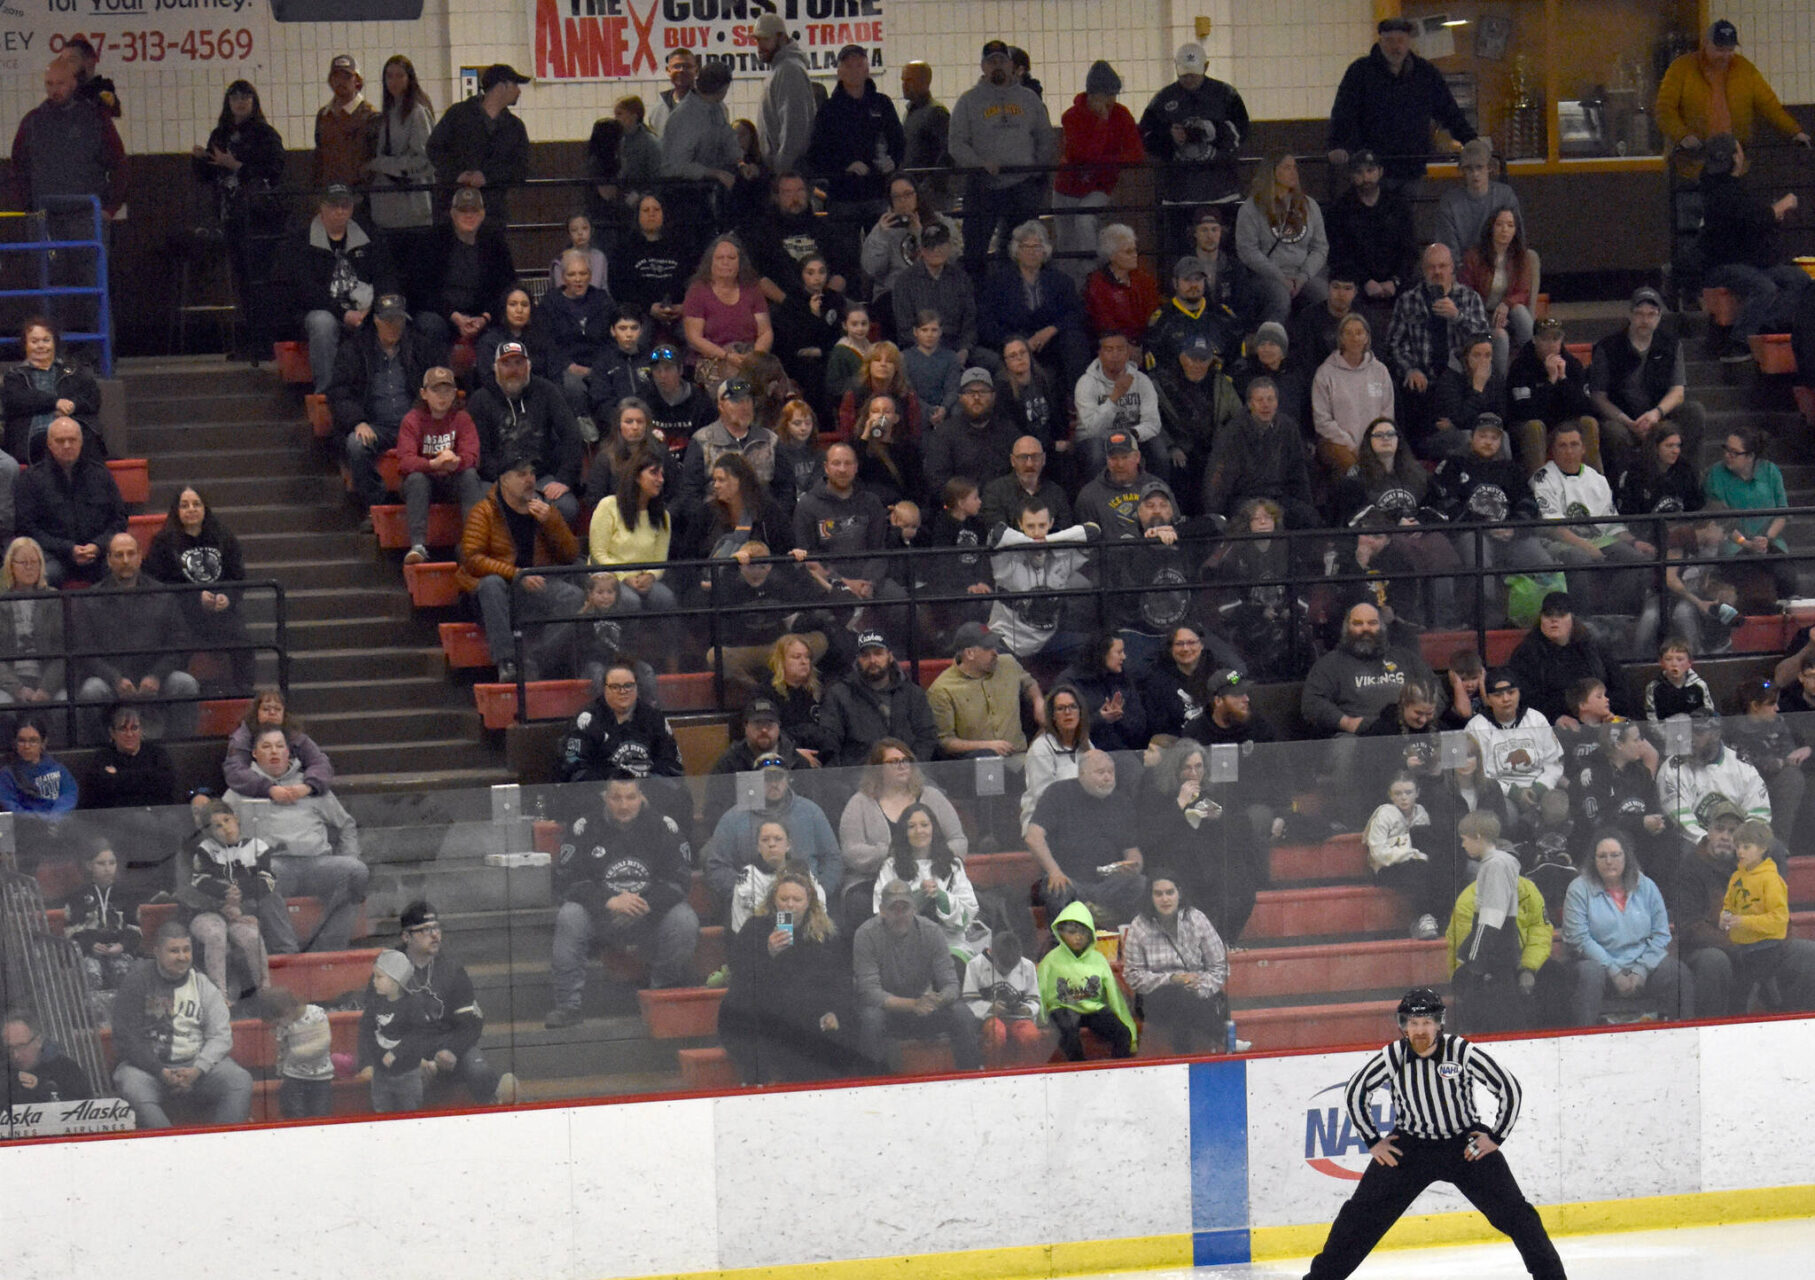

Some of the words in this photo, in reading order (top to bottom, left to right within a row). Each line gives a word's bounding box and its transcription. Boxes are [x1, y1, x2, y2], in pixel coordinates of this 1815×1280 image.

[535, 0, 658, 78] ANNEX
[664, 26, 710, 48] BUY
[805, 21, 884, 46] TRADE
[1355, 671, 1405, 688] VIKINGS
[60, 1099, 131, 1122] Alaska
[65, 1123, 127, 1134] AIRLINES
